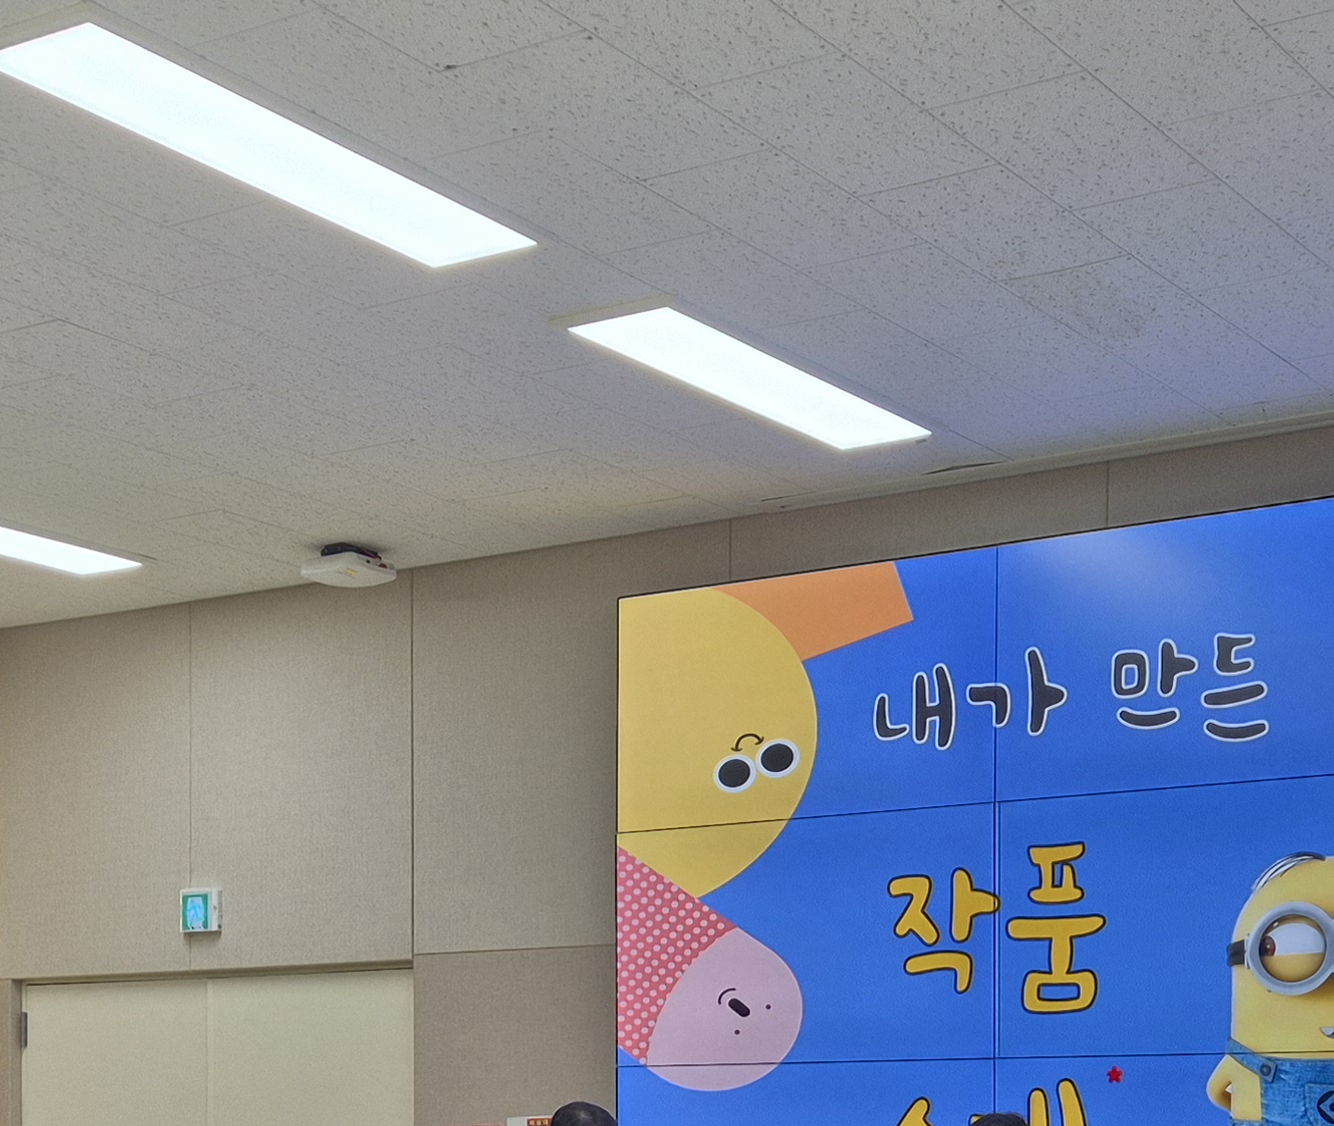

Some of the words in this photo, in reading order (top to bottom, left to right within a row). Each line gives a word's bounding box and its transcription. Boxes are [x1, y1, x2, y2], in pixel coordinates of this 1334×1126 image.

[873, 646, 1067, 750] 내가
[1111, 632, 1268, 741] 만든
[887, 840, 1107, 1014] 작품
